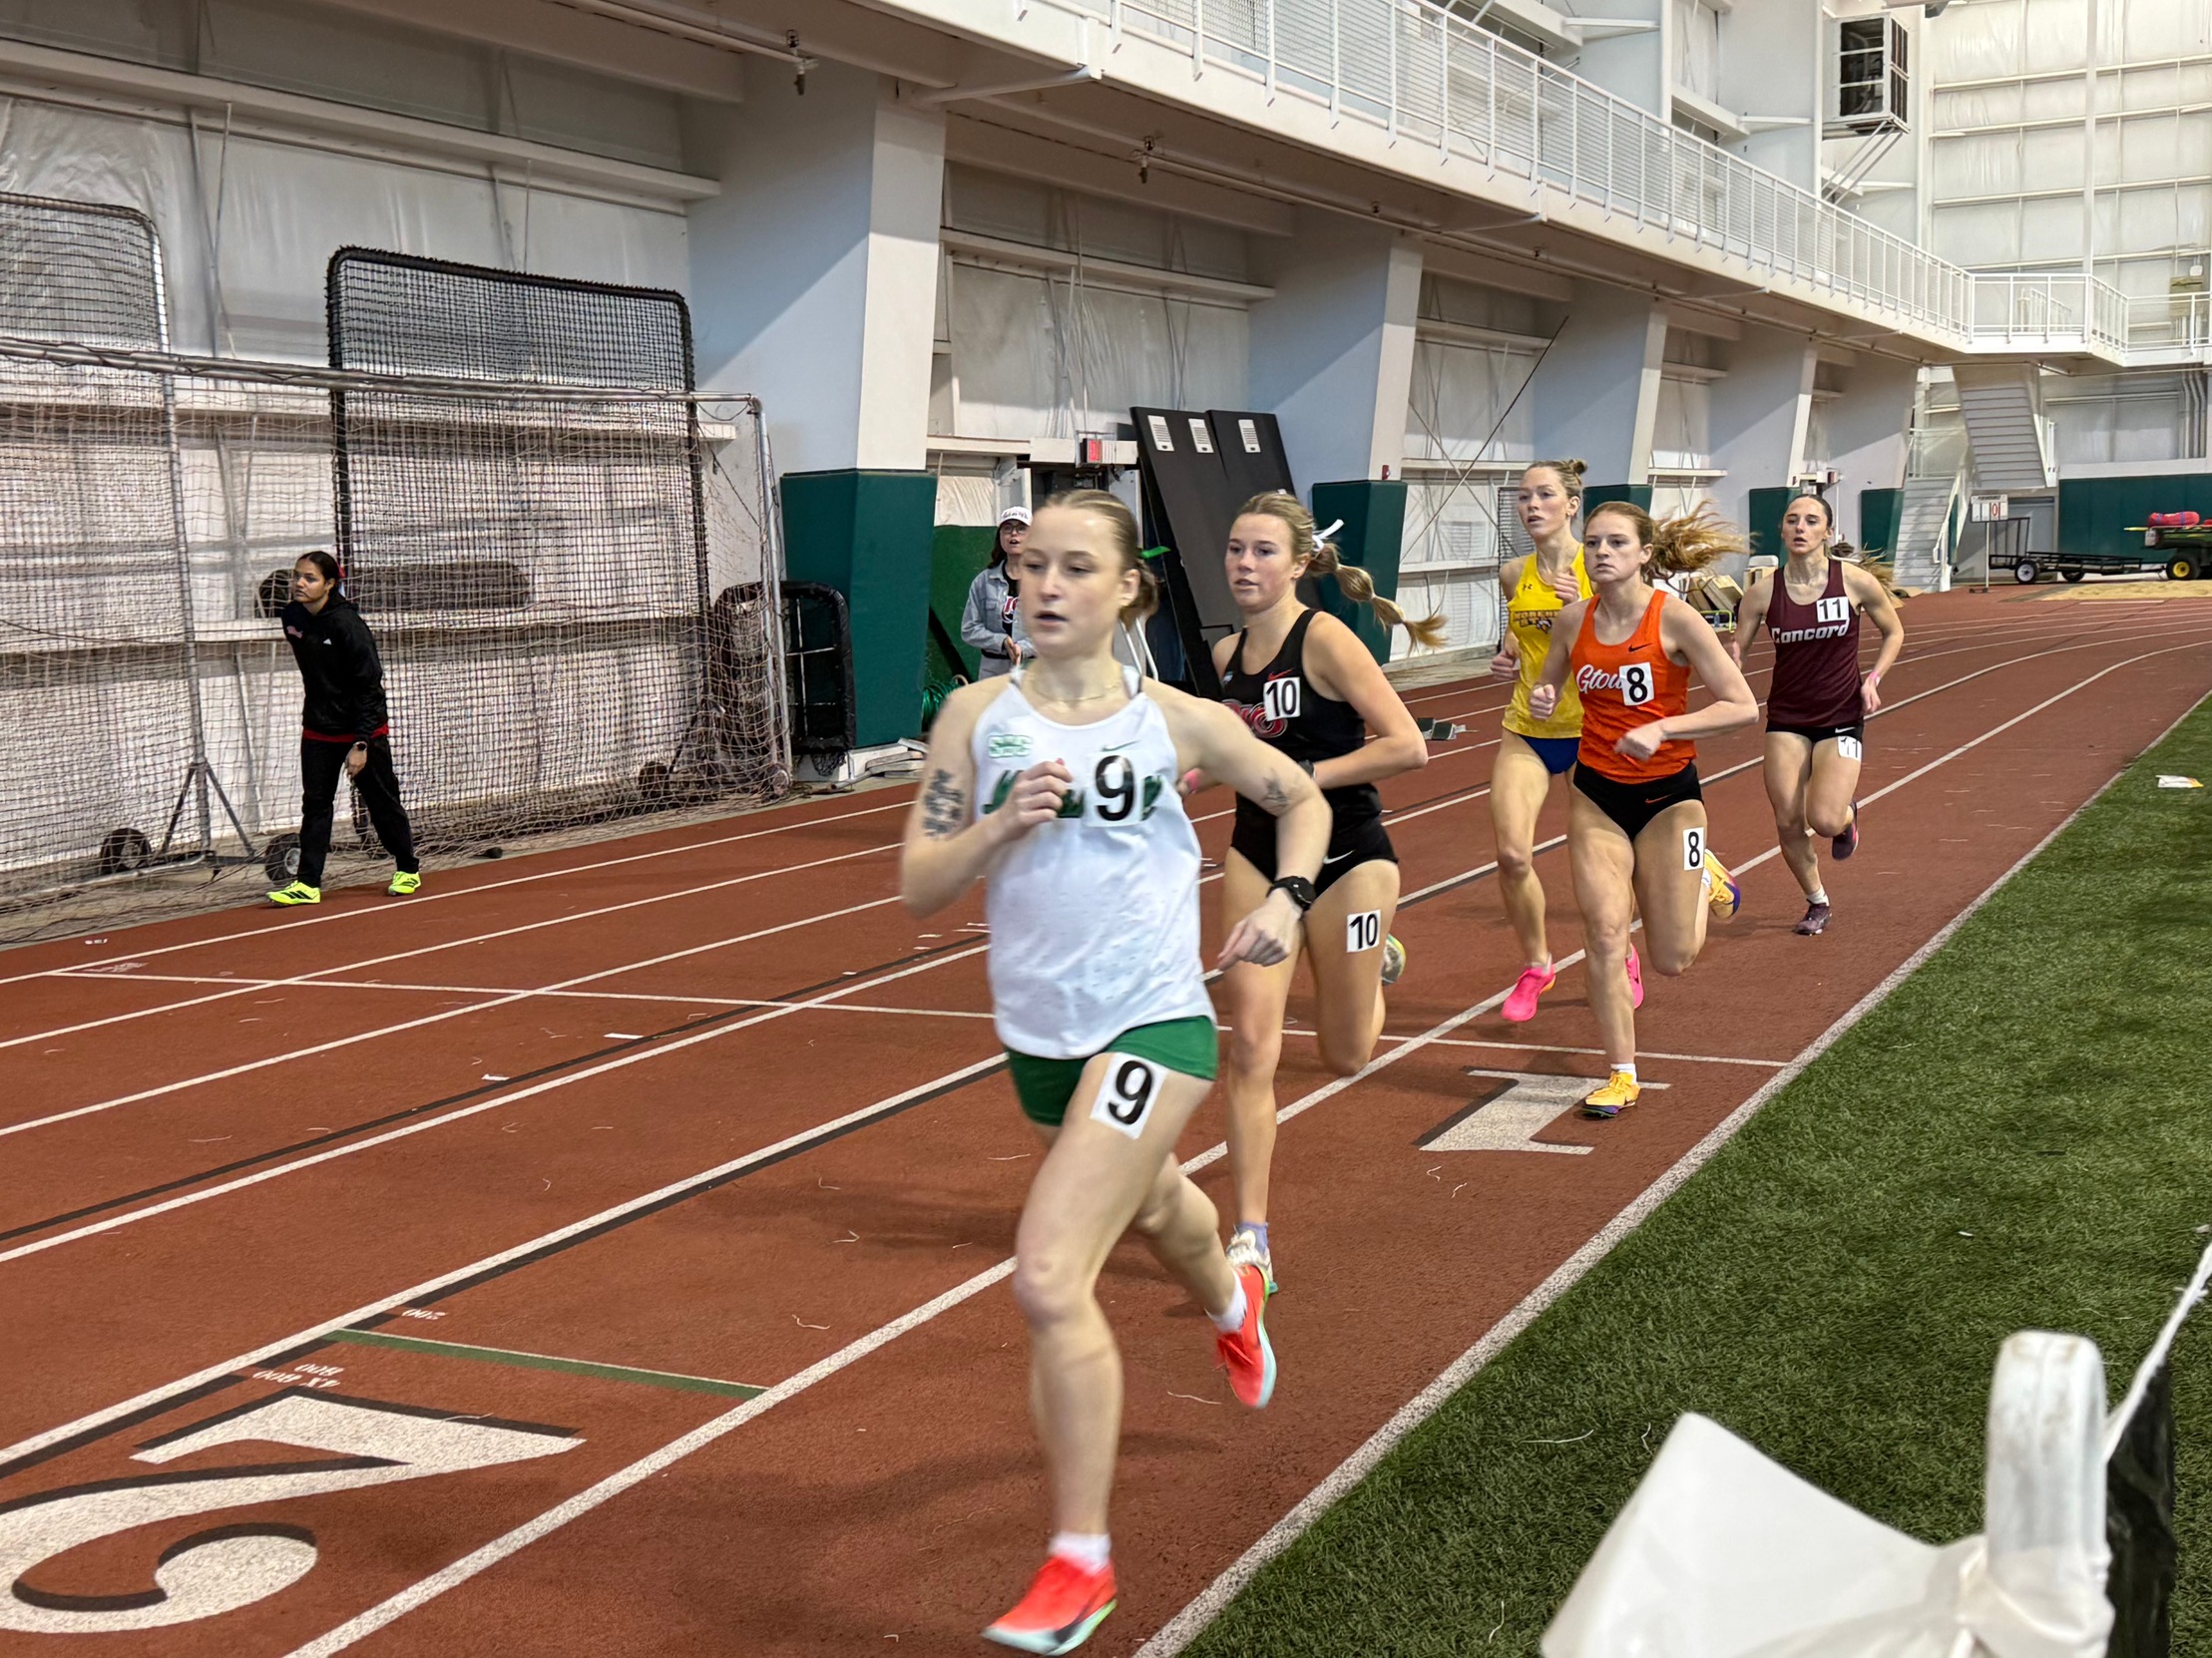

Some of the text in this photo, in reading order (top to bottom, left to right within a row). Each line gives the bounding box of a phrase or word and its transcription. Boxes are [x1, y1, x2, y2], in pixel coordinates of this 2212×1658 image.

[1819, 598, 1842, 621] 11
[1770, 618, 1851, 644] Concord
[1266, 679, 1297, 717] 10
[1626, 666, 1648, 703] 8
[1096, 754, 1135, 822] 9
[1687, 830, 1701, 868] 8
[1349, 913, 1379, 951] 10
[1107, 1059, 1152, 1125] 9
